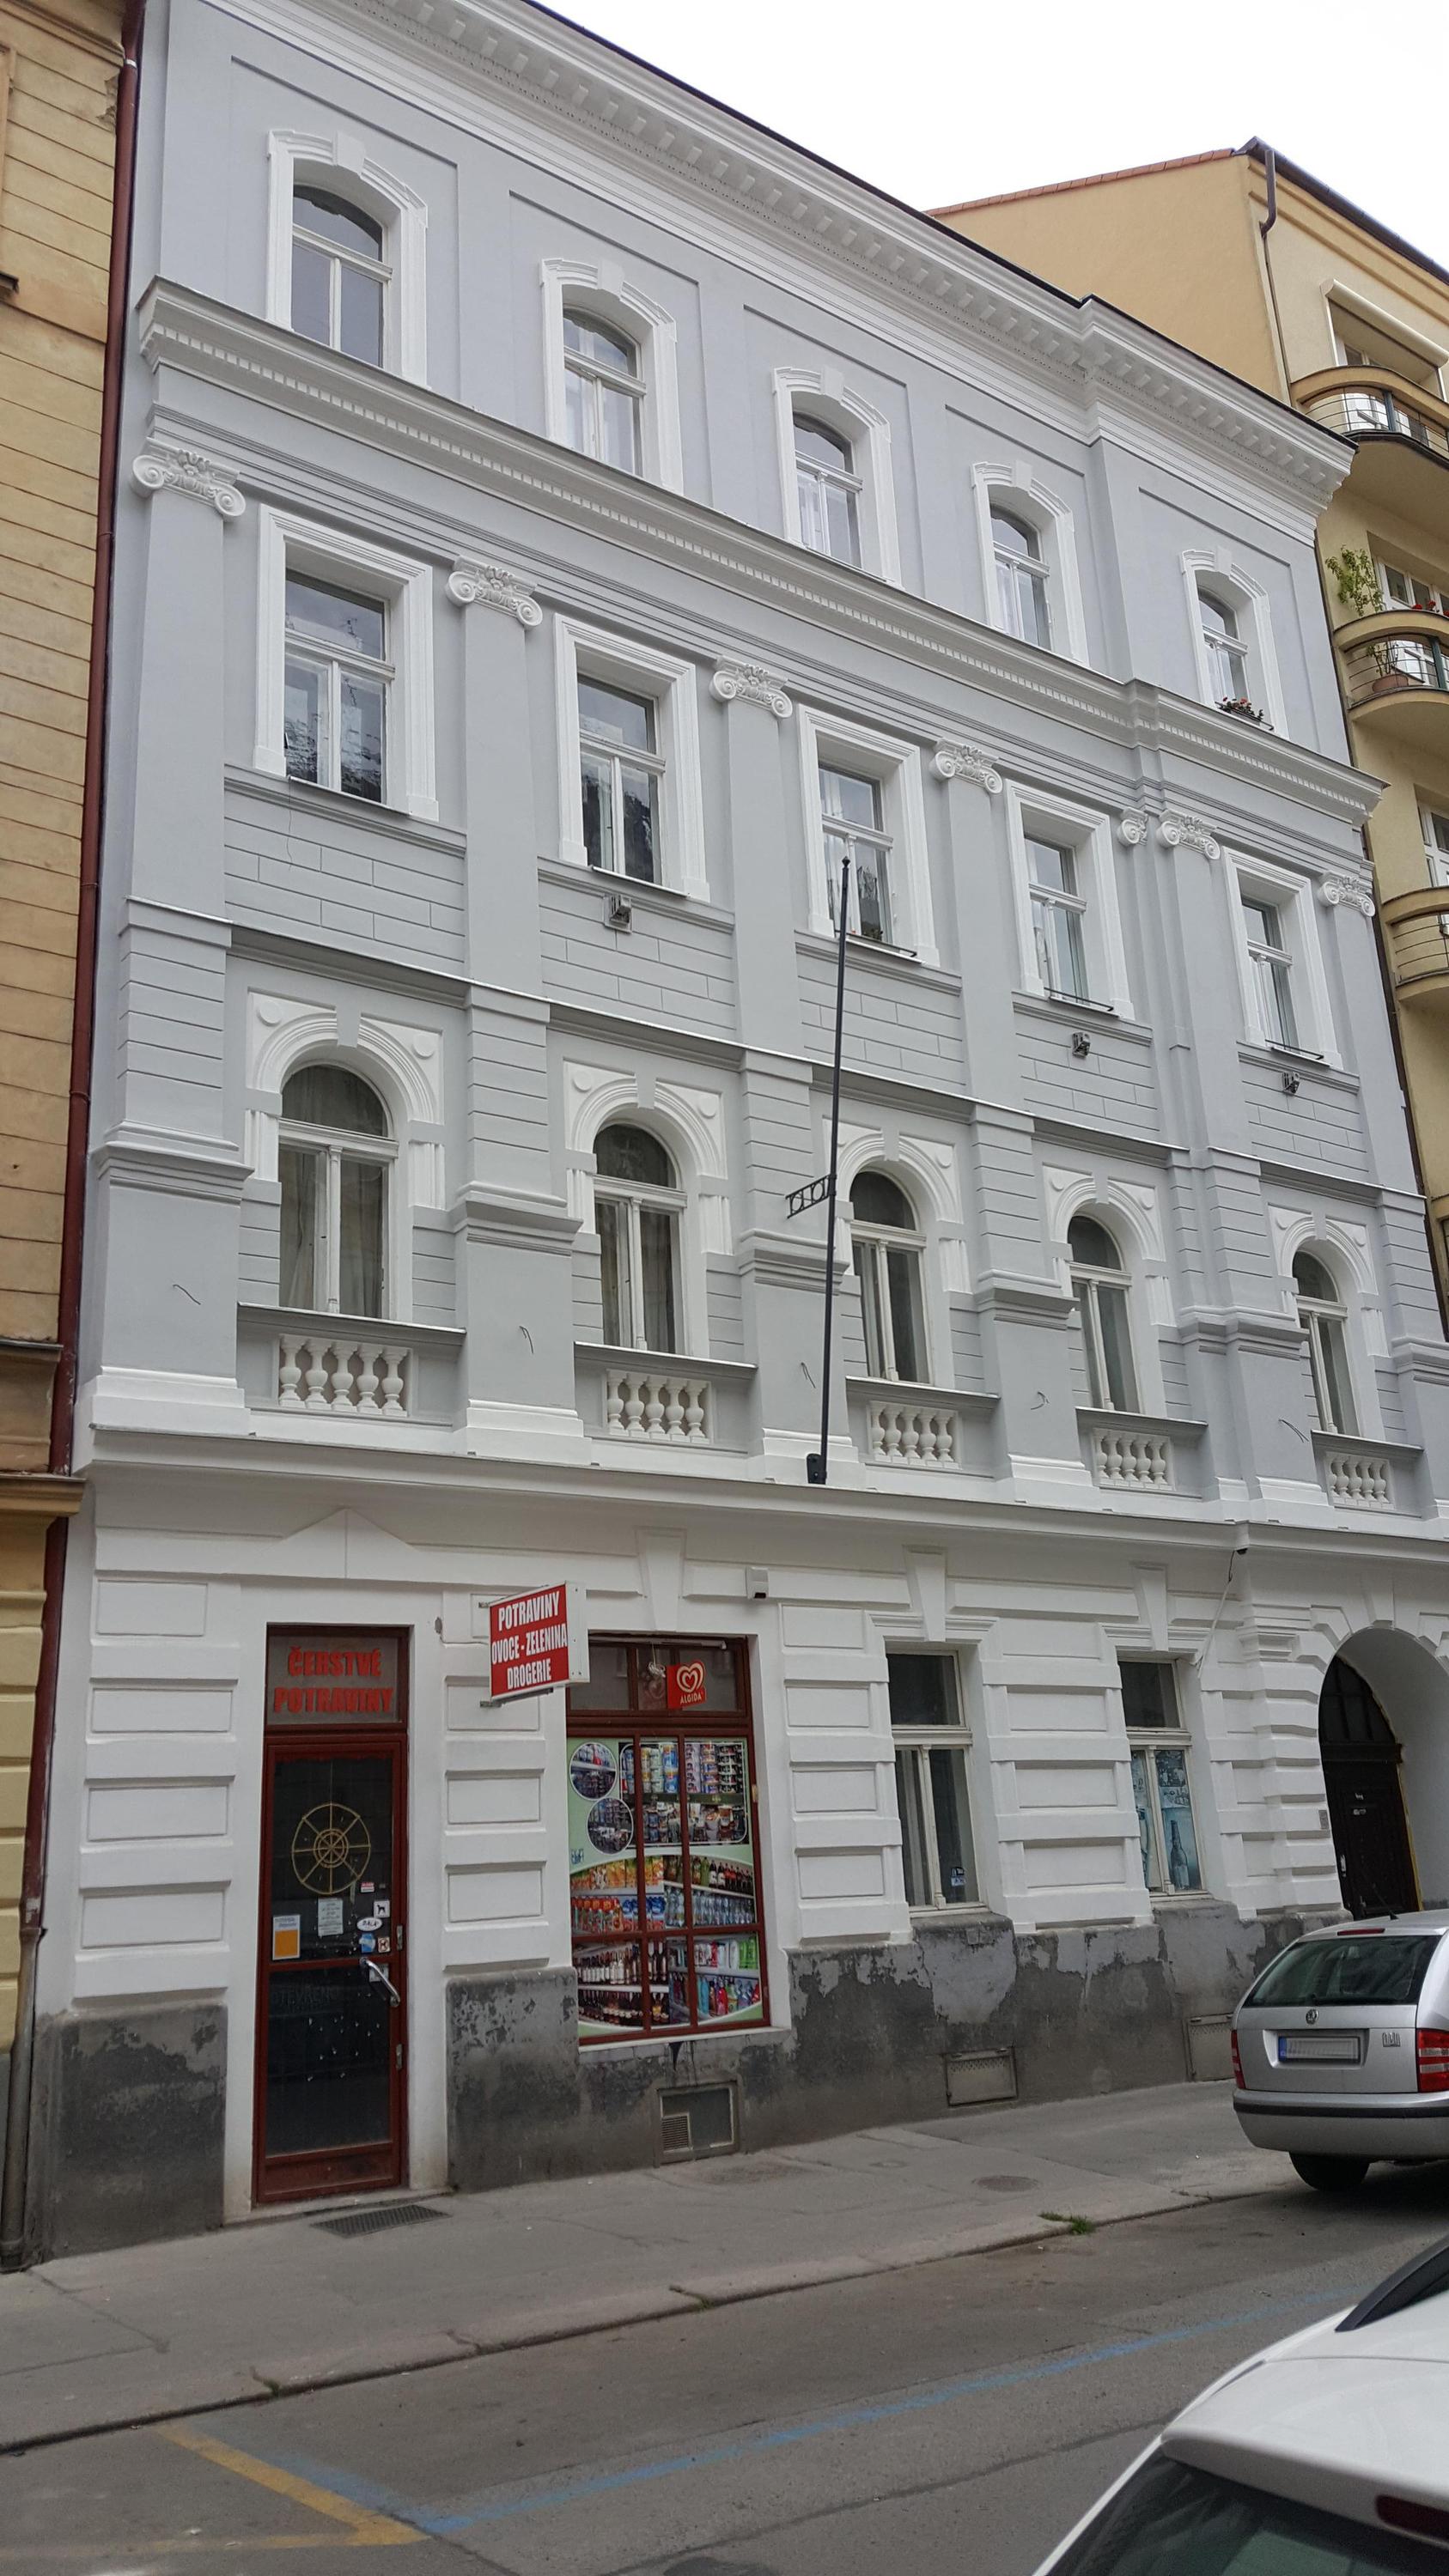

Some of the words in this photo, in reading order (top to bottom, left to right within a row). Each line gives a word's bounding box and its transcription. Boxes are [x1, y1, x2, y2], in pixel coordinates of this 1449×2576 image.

[498, 1590, 560, 1631] POTRAVINY
[491, 1635, 520, 1665] OVOCE
[526, 1623, 568, 1656] ZELENINA
[507, 1658, 551, 1690] DROGERIE
[274, 1687, 393, 1713] POTRAVINY
[680, 1692, 702, 1705] ALGIDA
